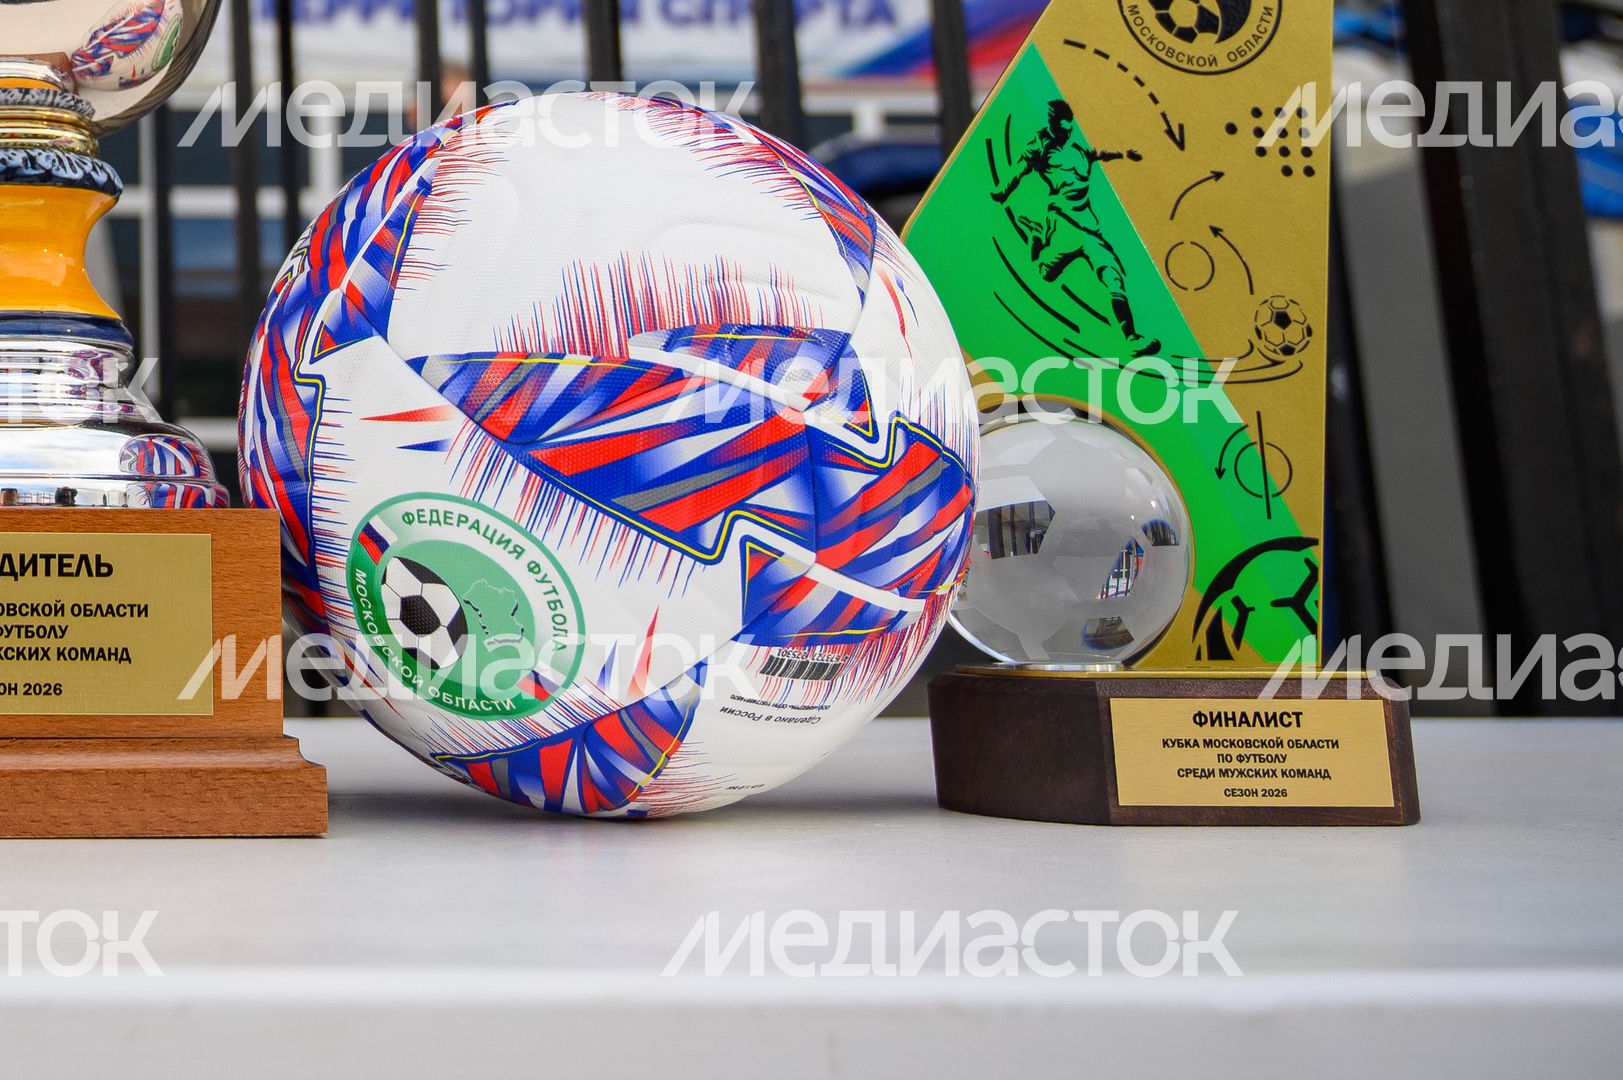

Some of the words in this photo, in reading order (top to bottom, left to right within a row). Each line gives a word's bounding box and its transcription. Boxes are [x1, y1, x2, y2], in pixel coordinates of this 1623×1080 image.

[1127, 3, 1219, 68] МОСКОВСКОЙ
[1226, 6, 1274, 63] ОБЛАСТИ
[401, 508, 526, 561] ФЕДЕРАЦИЯ
[526, 559, 569, 653] ФУТБОЛА
[70, 602, 149, 618] ОБЛАСТИ
[354, 567, 425, 690] МОСКОВСКОЙ
[427, 686, 518, 713] ОБЛАСТИ
[56, 646, 132, 665] КОМАНД
[22, 682, 63, 696] 2026
[719, 706, 764, 722] России
[1192, 710, 1304, 728] ФИНАЛИСТ
[1161, 738, 1201, 749] КУБКА
[1202, 736, 1284, 749] МОСКОВСКОЙ
[1286, 738, 1340, 749] ОБЛАСТИ
[1216, 753, 1233, 764] ПО
[1235, 753, 1288, 764] ФУТБОЛУ
[1176, 767, 1216, 779] СРЕДИ
[1218, 768, 1278, 779] МУЖСКИХ
[1280, 768, 1332, 781] КОМАНД
[1223, 787, 1259, 798] СЕЗОН
[1260, 788, 1288, 798] 2026
